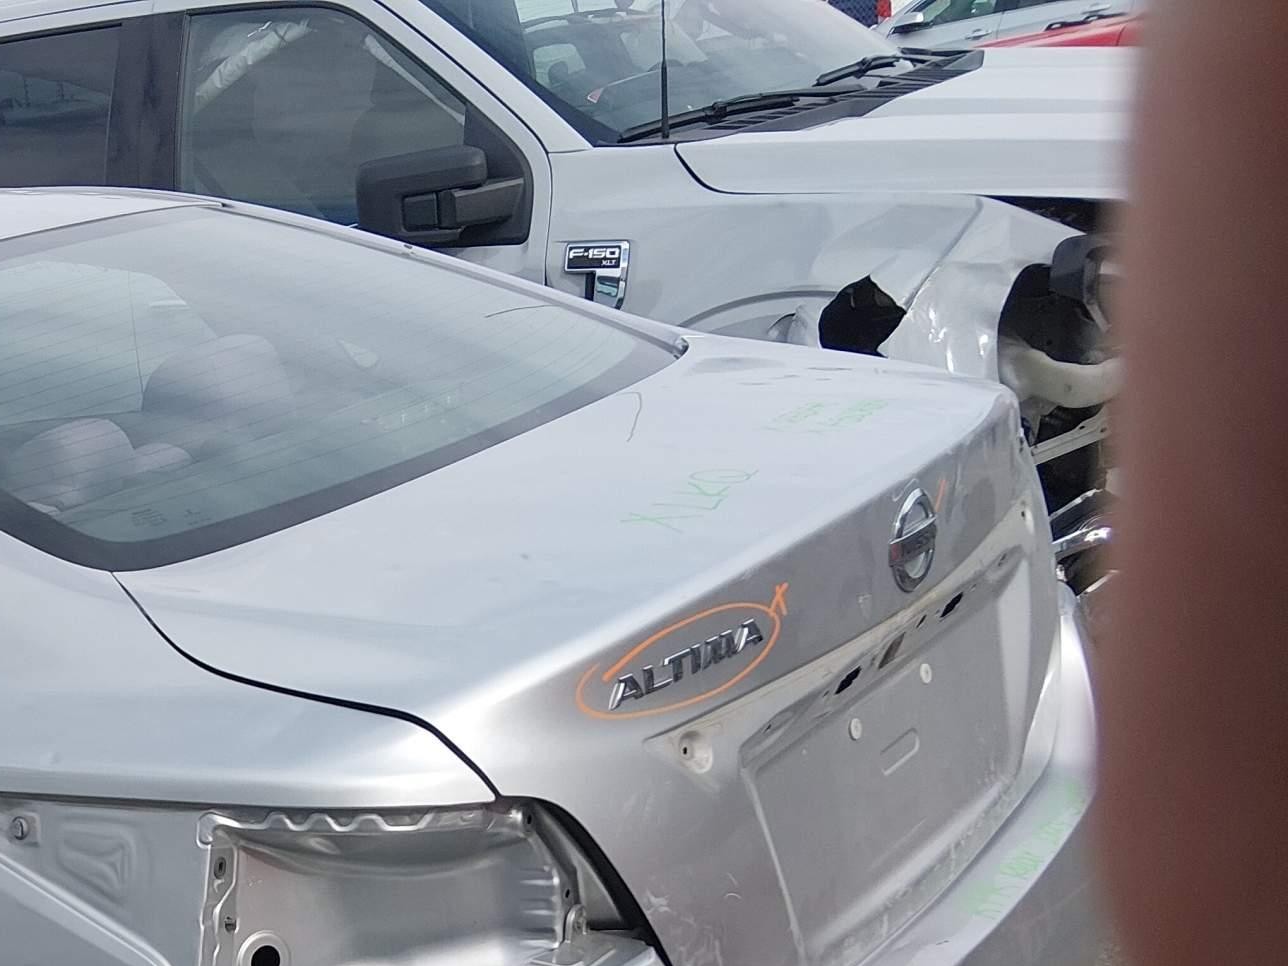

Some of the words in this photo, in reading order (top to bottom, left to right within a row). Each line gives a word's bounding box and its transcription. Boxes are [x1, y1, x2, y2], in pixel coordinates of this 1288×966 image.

[568, 247, 621, 260] F-150
[600, 259, 617, 267] XLT
[608, 618, 764, 712] ALTIMA
